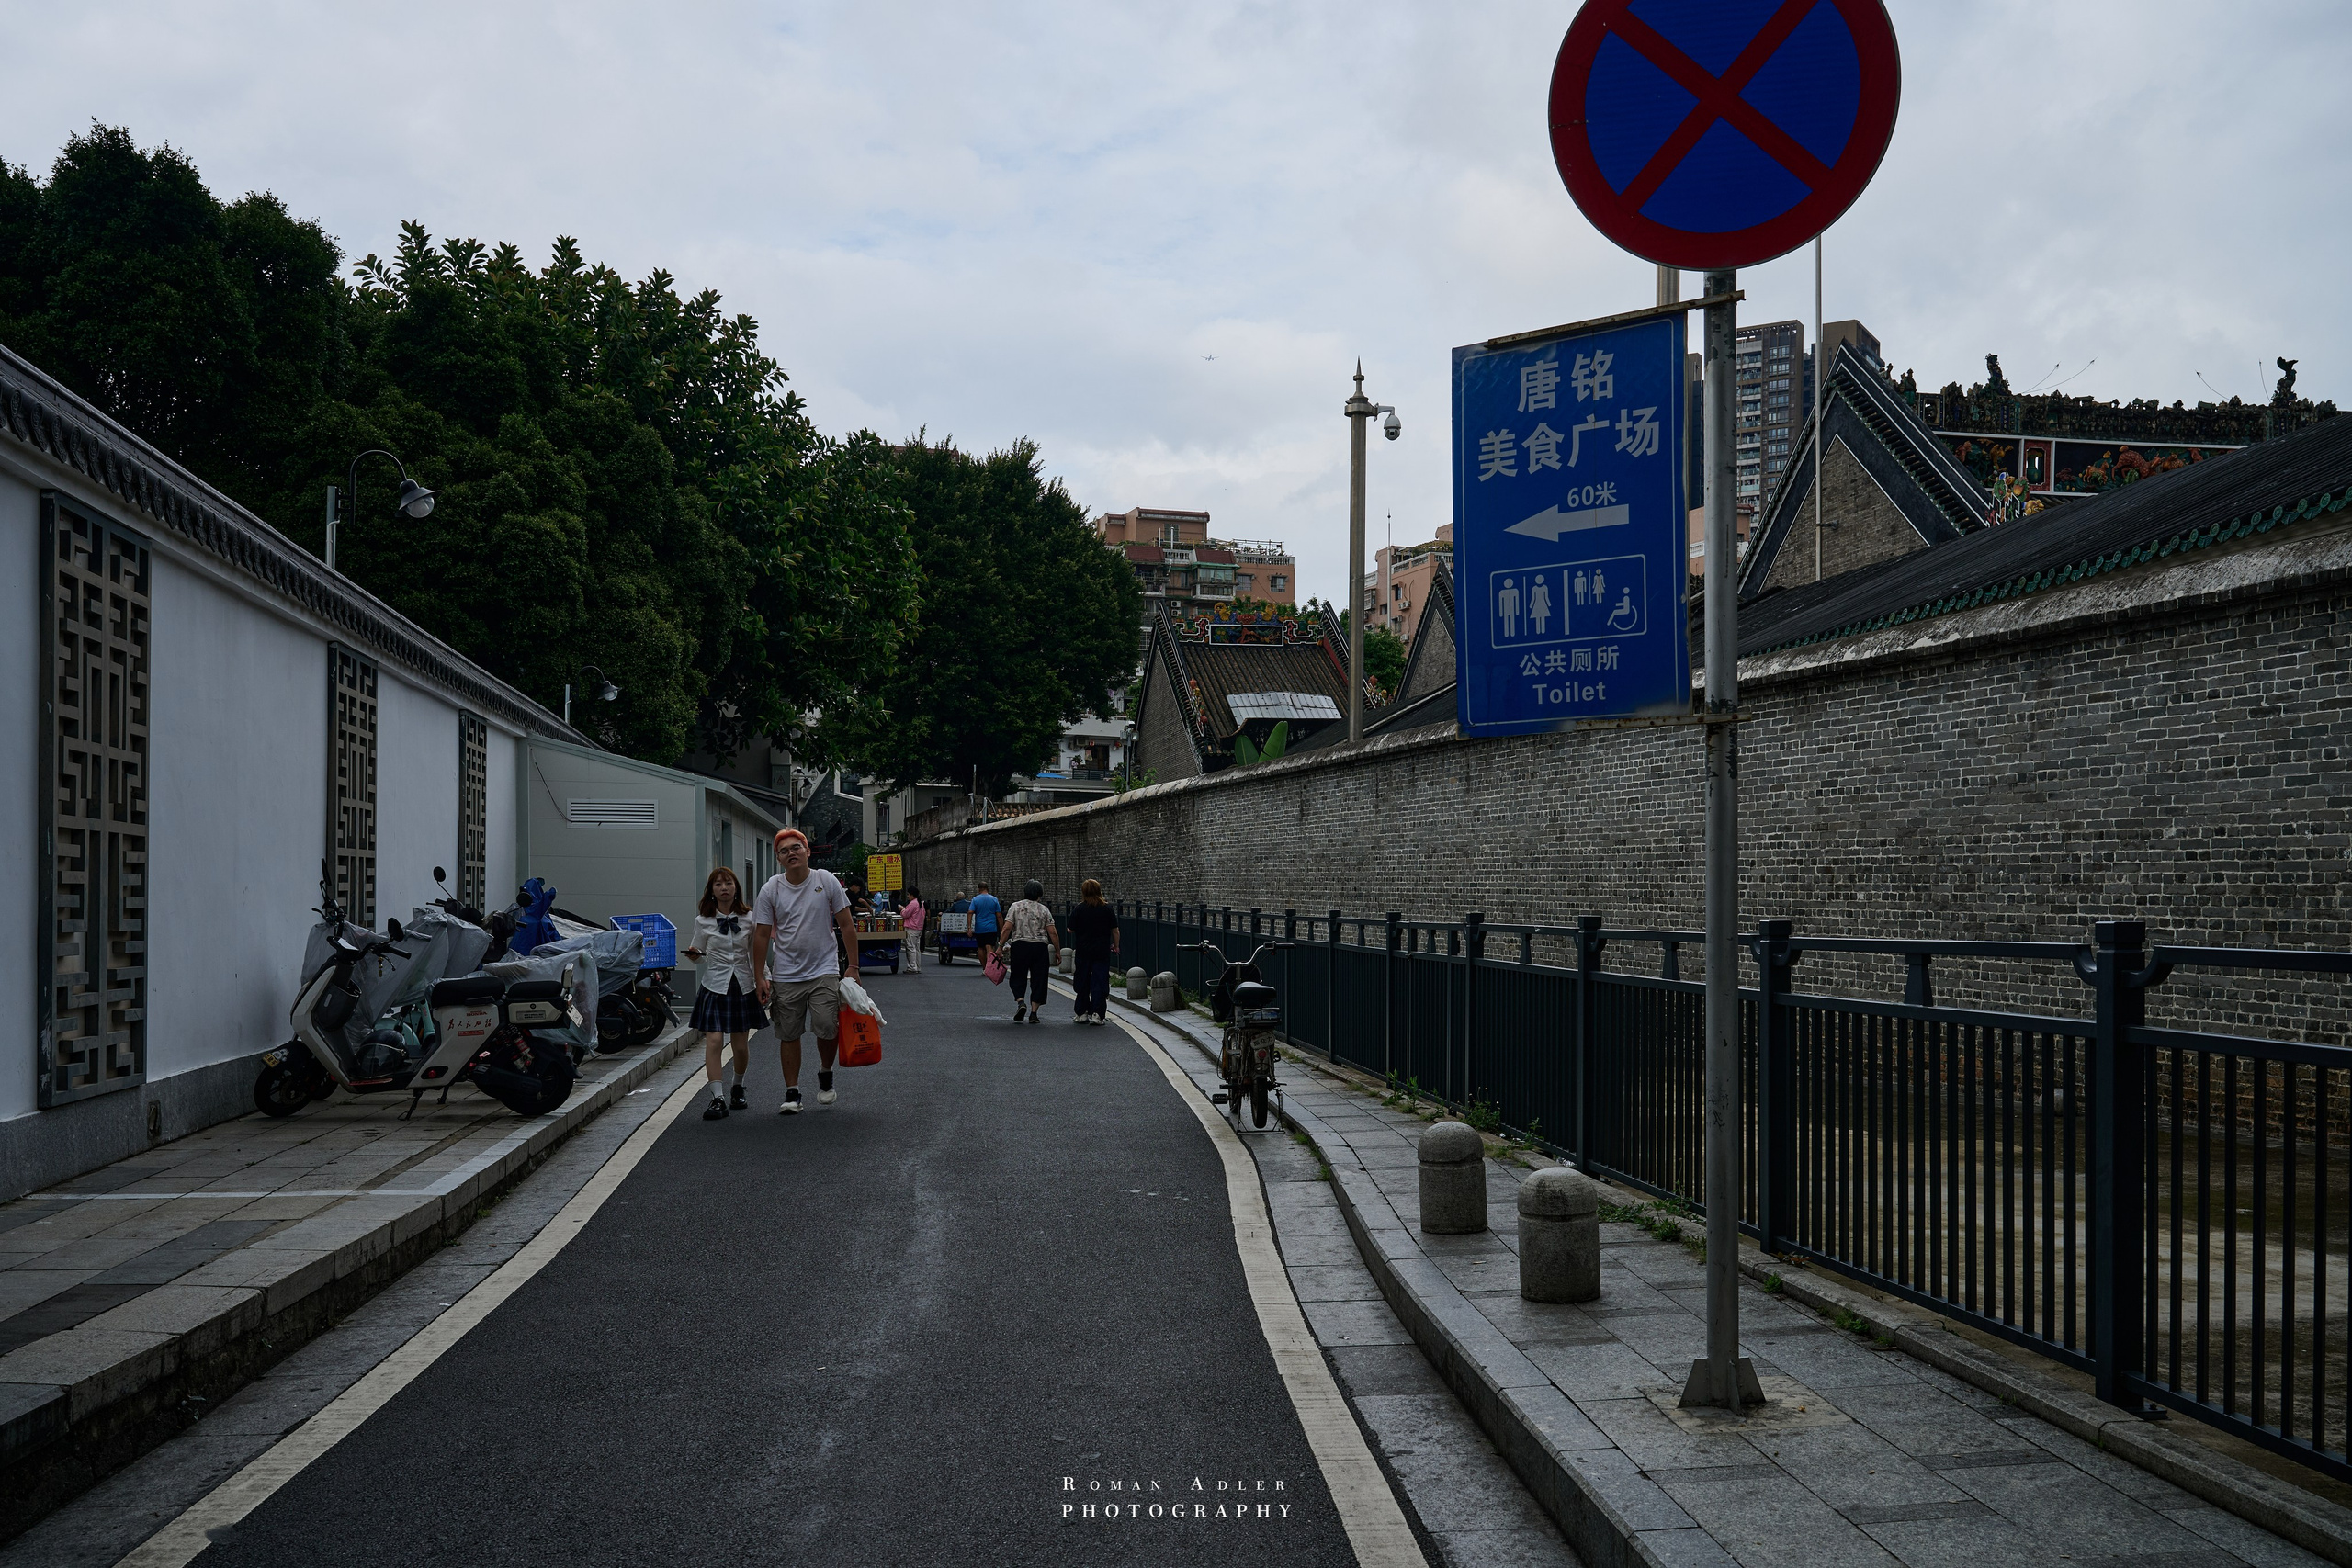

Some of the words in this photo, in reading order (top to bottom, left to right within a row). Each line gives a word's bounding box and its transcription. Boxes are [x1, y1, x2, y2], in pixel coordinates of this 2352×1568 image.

[1517, 349, 1615, 412] 唐铭
[1477, 406, 1660, 482] 美食广场
[1566, 481, 1617, 507] 60米
[1520, 645, 1620, 678] 公共厕所
[1532, 682, 1606, 704] Toilet
[869, 855, 883, 863] 广东
